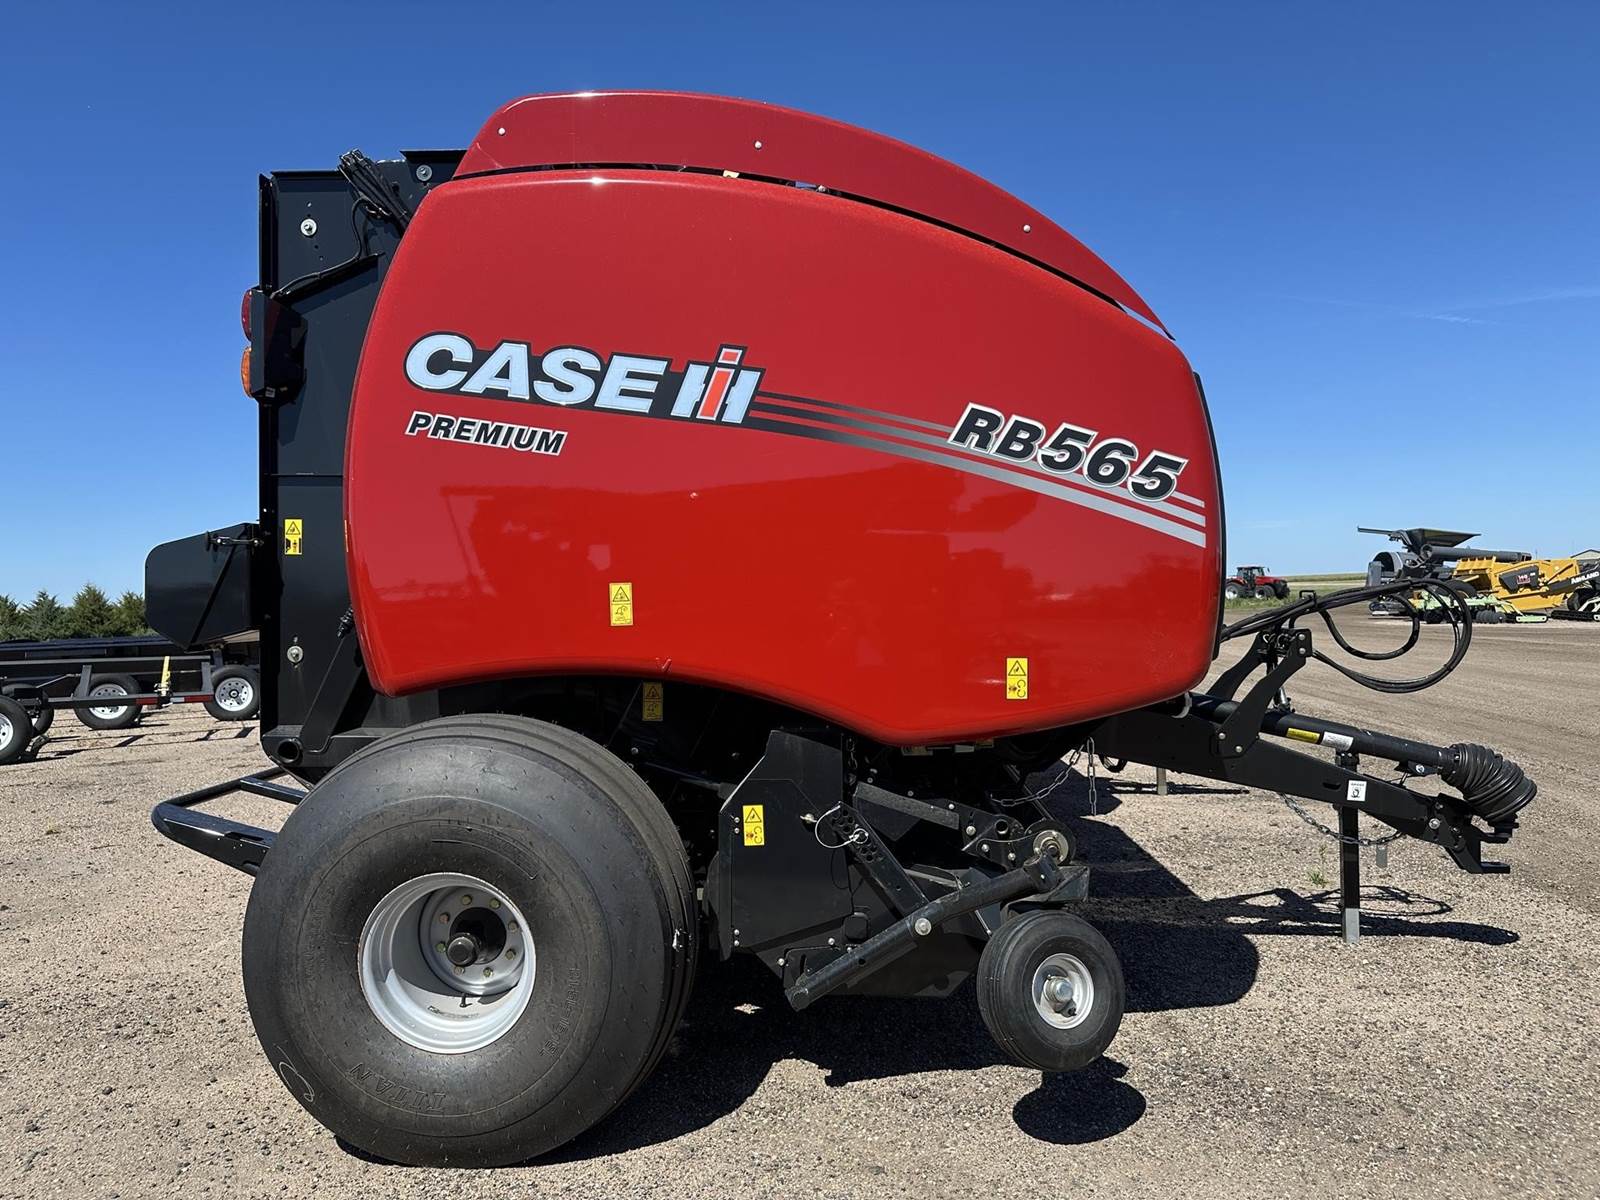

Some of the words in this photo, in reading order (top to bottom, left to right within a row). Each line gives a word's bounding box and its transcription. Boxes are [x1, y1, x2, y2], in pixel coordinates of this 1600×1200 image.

[404, 333, 669, 414] CASE
[405, 411, 568, 456] PREMIUM
[947, 402, 1189, 501] RB565
[349, 1062, 447, 1112] TITAN
